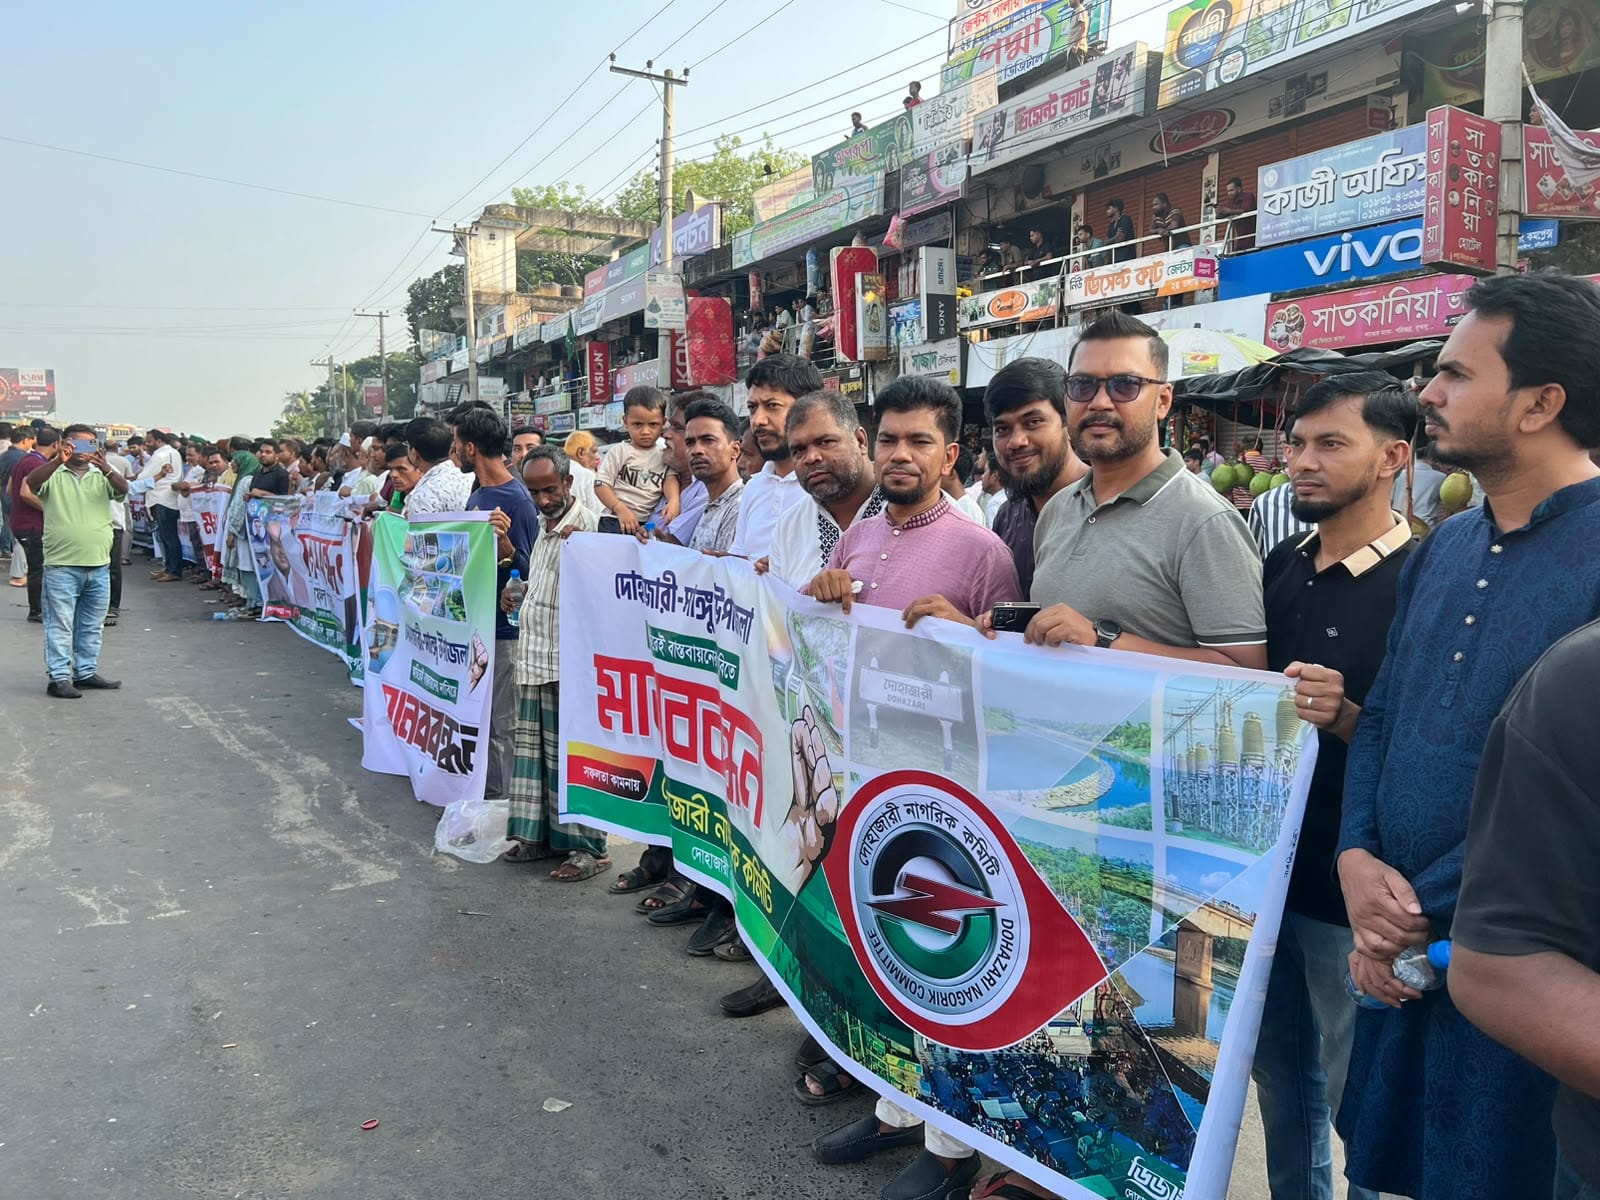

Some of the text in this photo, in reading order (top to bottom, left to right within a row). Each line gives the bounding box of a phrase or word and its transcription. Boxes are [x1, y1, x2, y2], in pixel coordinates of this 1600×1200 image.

[1263, 166, 1337, 215] কাজী
[1303, 232, 1423, 276] vivo
[1084, 268, 1132, 297] ডিসেন্ট
[1135, 260, 1165, 285] কাট
[938, 301, 946, 335] SONY
[1311, 286, 1443, 334] সাতকানিয়া
[593, 352, 605, 395] VISION
[886, 693, 926, 711] DOHAZARI
[858, 801, 1002, 877] দোহাজারী নাগরিক কমিটি
[866, 918, 1014, 1008] DOHAZARI NAGORIK COMMITTEE
